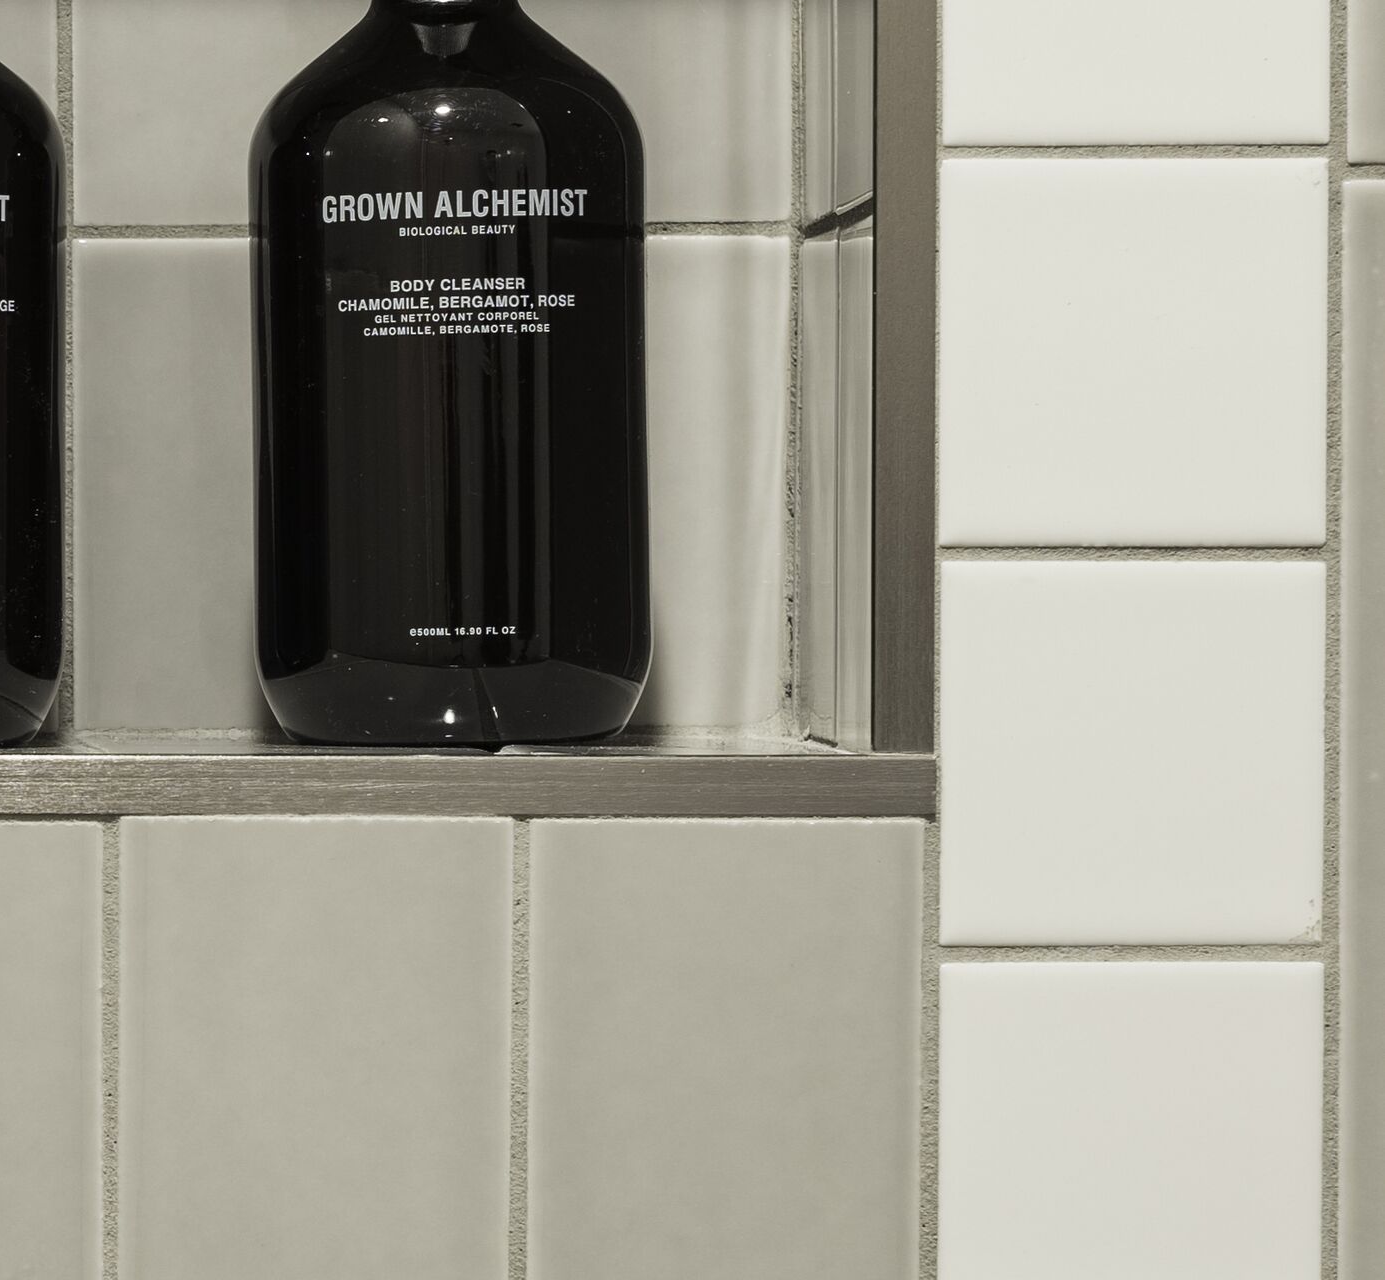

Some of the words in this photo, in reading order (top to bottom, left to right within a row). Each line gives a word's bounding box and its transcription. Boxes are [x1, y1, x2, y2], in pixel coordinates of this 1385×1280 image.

[323, 192, 423, 223] GROWN
[434, 189, 587, 218] ALCHEMIST
[399, 226, 467, 236] BIOLOGICAL
[472, 225, 515, 234] BEAUTY
[390, 279, 435, 292] BODY
[440, 278, 525, 291] CLEANSER
[338, 297, 434, 312] CHAMOMILE,
[439, 295, 533, 309] BERGAMOT,
[538, 295, 575, 307] ROSE
[375, 315, 396, 323] GEL
[401, 313, 473, 322] NETTOYANT
[478, 312, 539, 321] CORPOREL
[364, 326, 435, 336] CAMOMILLE,
[440, 324, 517, 334] BERGAMOTE,
[521, 324, 550, 332] ROSE
[455, 627, 482, 635] 16.90
[502, 626, 516, 634] OZ
